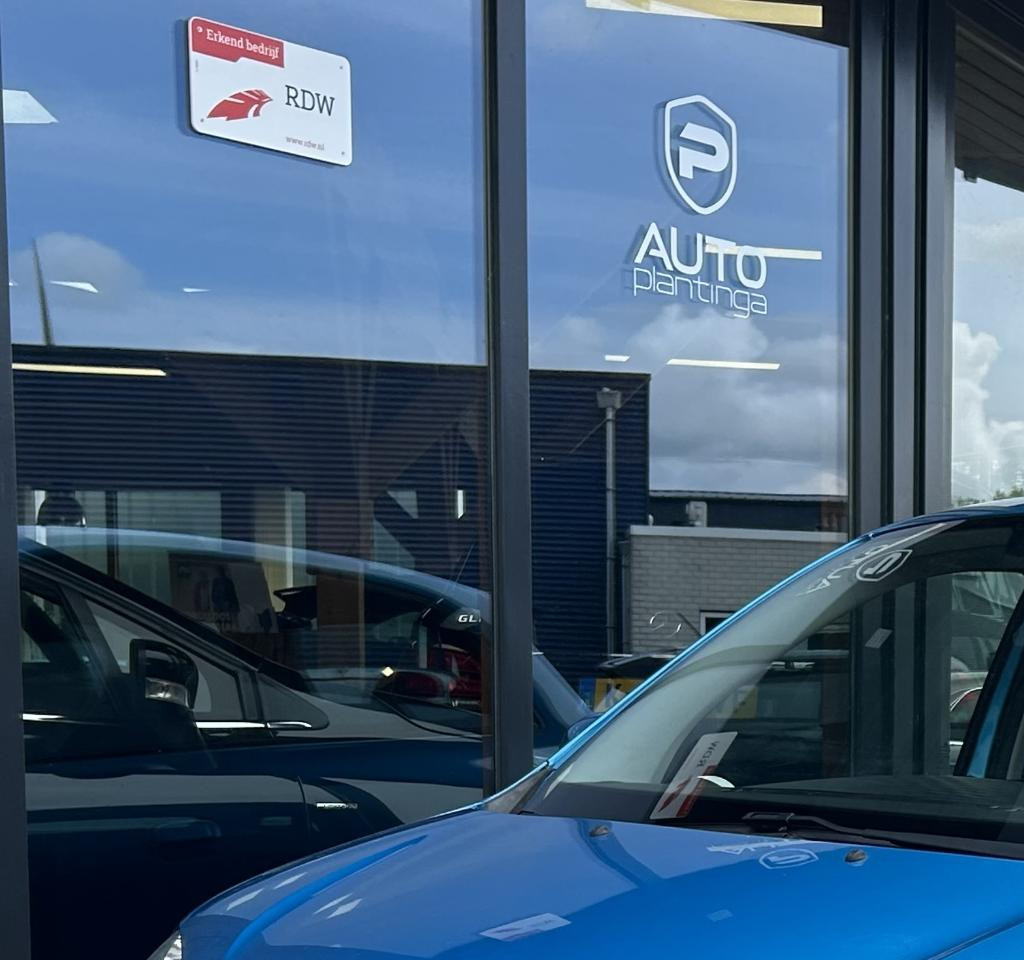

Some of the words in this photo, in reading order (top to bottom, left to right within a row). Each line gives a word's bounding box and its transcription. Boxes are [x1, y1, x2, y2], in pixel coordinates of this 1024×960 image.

[206, 29, 244, 49] Erkend
[246, 38, 280, 60] bedrijf
[285, 85, 335, 117] RDW
[286, 136, 325, 151] www.rdw.nl
[634, 222, 767, 290] AUTO
[633, 266, 768, 319] plantinga
